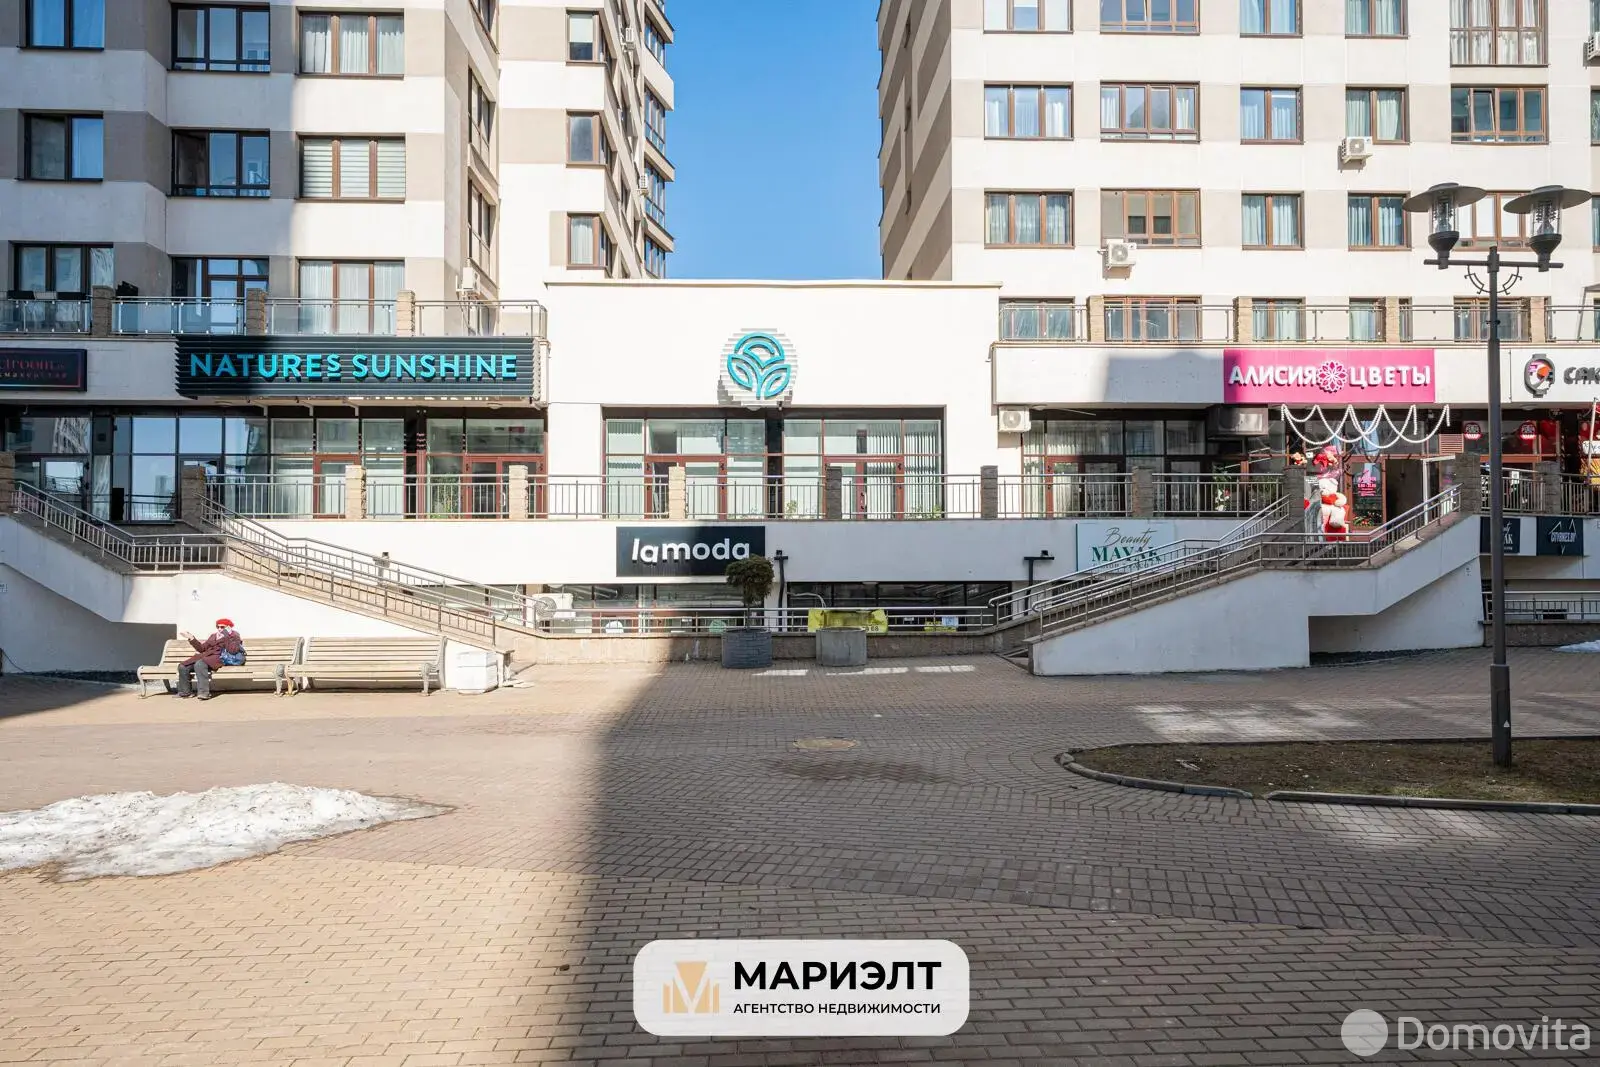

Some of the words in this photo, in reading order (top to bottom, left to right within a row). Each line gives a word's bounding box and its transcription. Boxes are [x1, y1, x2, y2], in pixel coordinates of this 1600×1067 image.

[351, 353, 518, 378] SUNSHINE
[1228, 365, 1317, 386] АЛИСИЯ
[1348, 365, 1431, 389] ЦВЕТЫ
[631, 537, 750, 563] lamoda
[1100, 526, 1158, 551] Beauty
